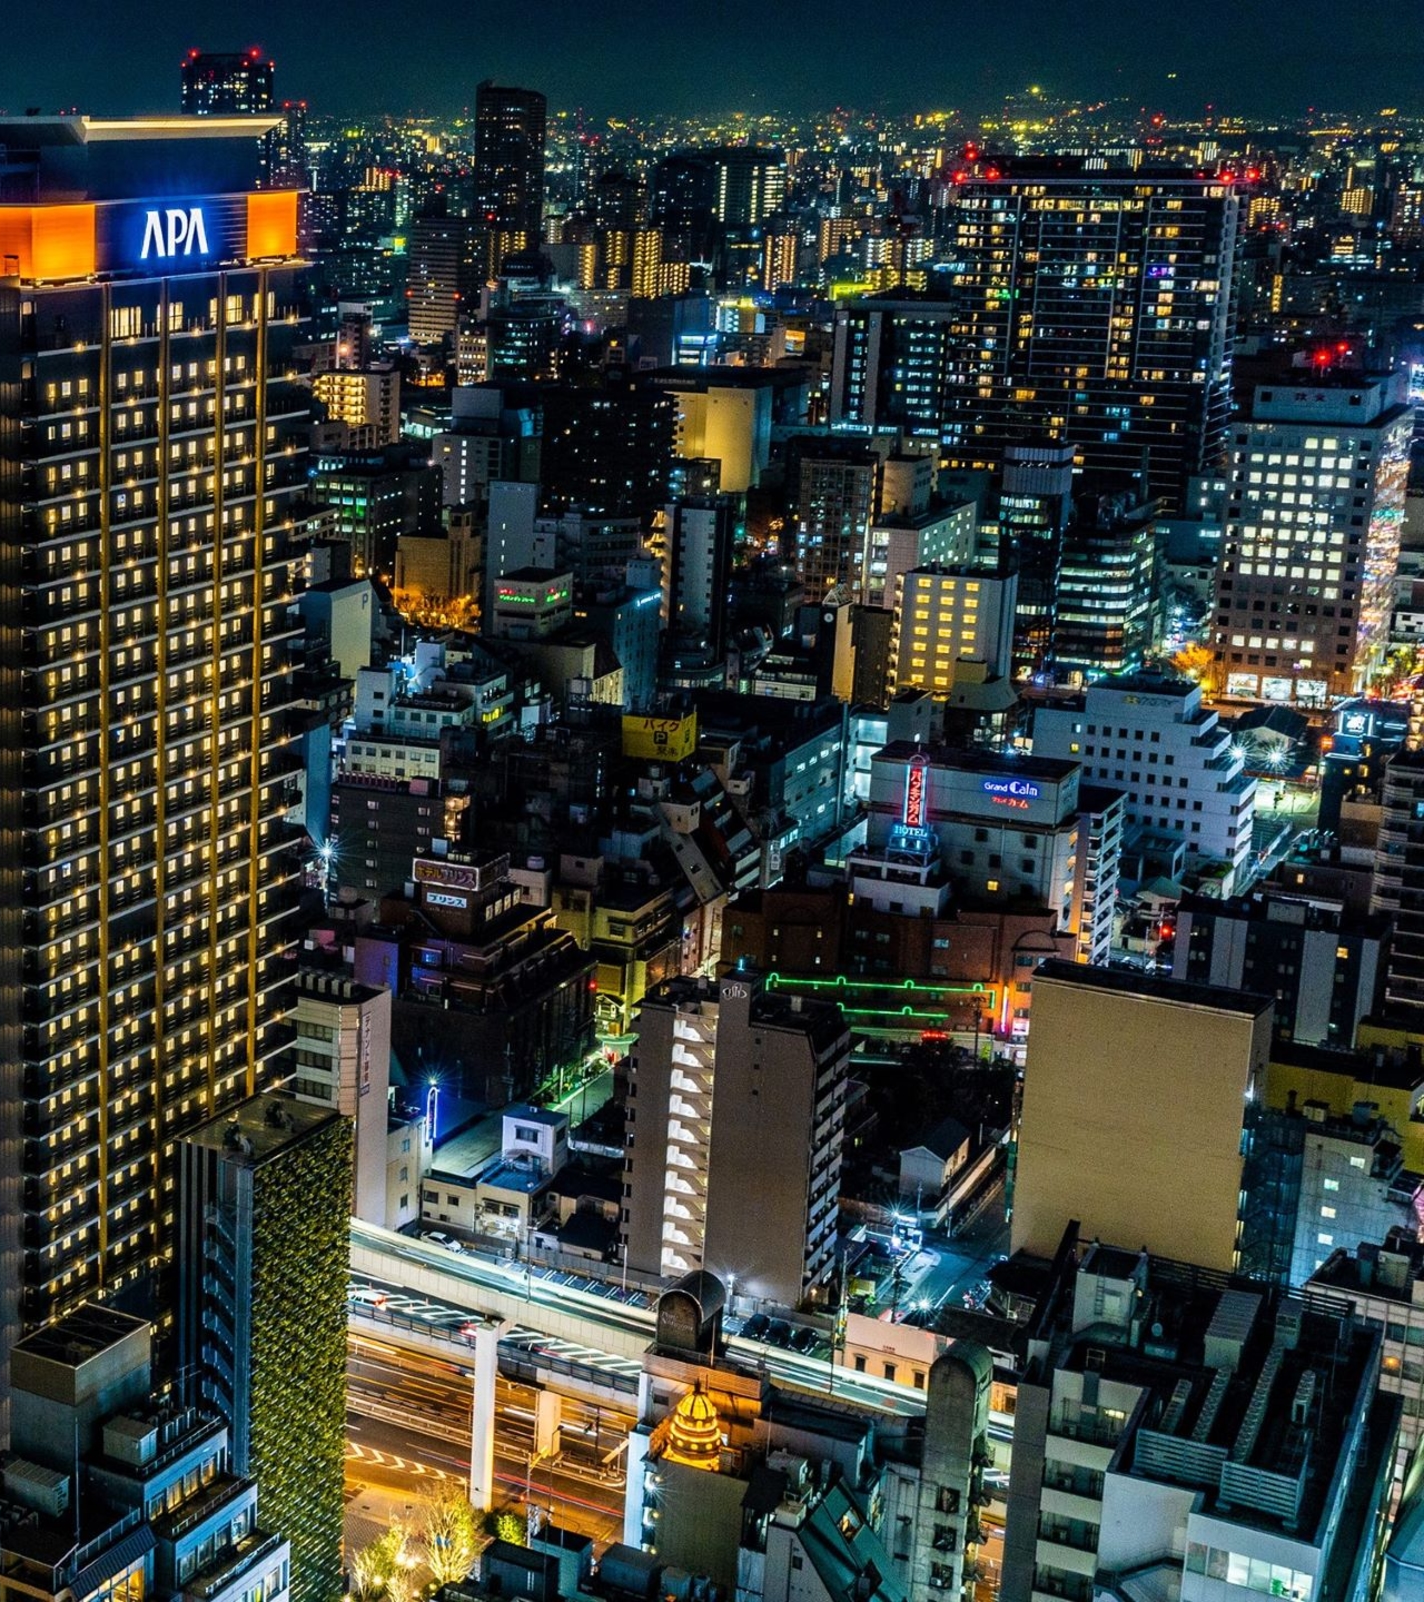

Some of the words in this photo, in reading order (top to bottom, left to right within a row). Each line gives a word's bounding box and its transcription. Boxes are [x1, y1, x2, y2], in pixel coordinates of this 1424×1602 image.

[139, 207, 209, 259] APA
[644, 719, 680, 732] バイク
[984, 782, 1008, 792] Grand
[1009, 781, 1038, 796] Calm
[908, 770, 922, 823] バッキンガム
[893, 825, 928, 838] HOTEL
[428, 894, 465, 908] プリンス
